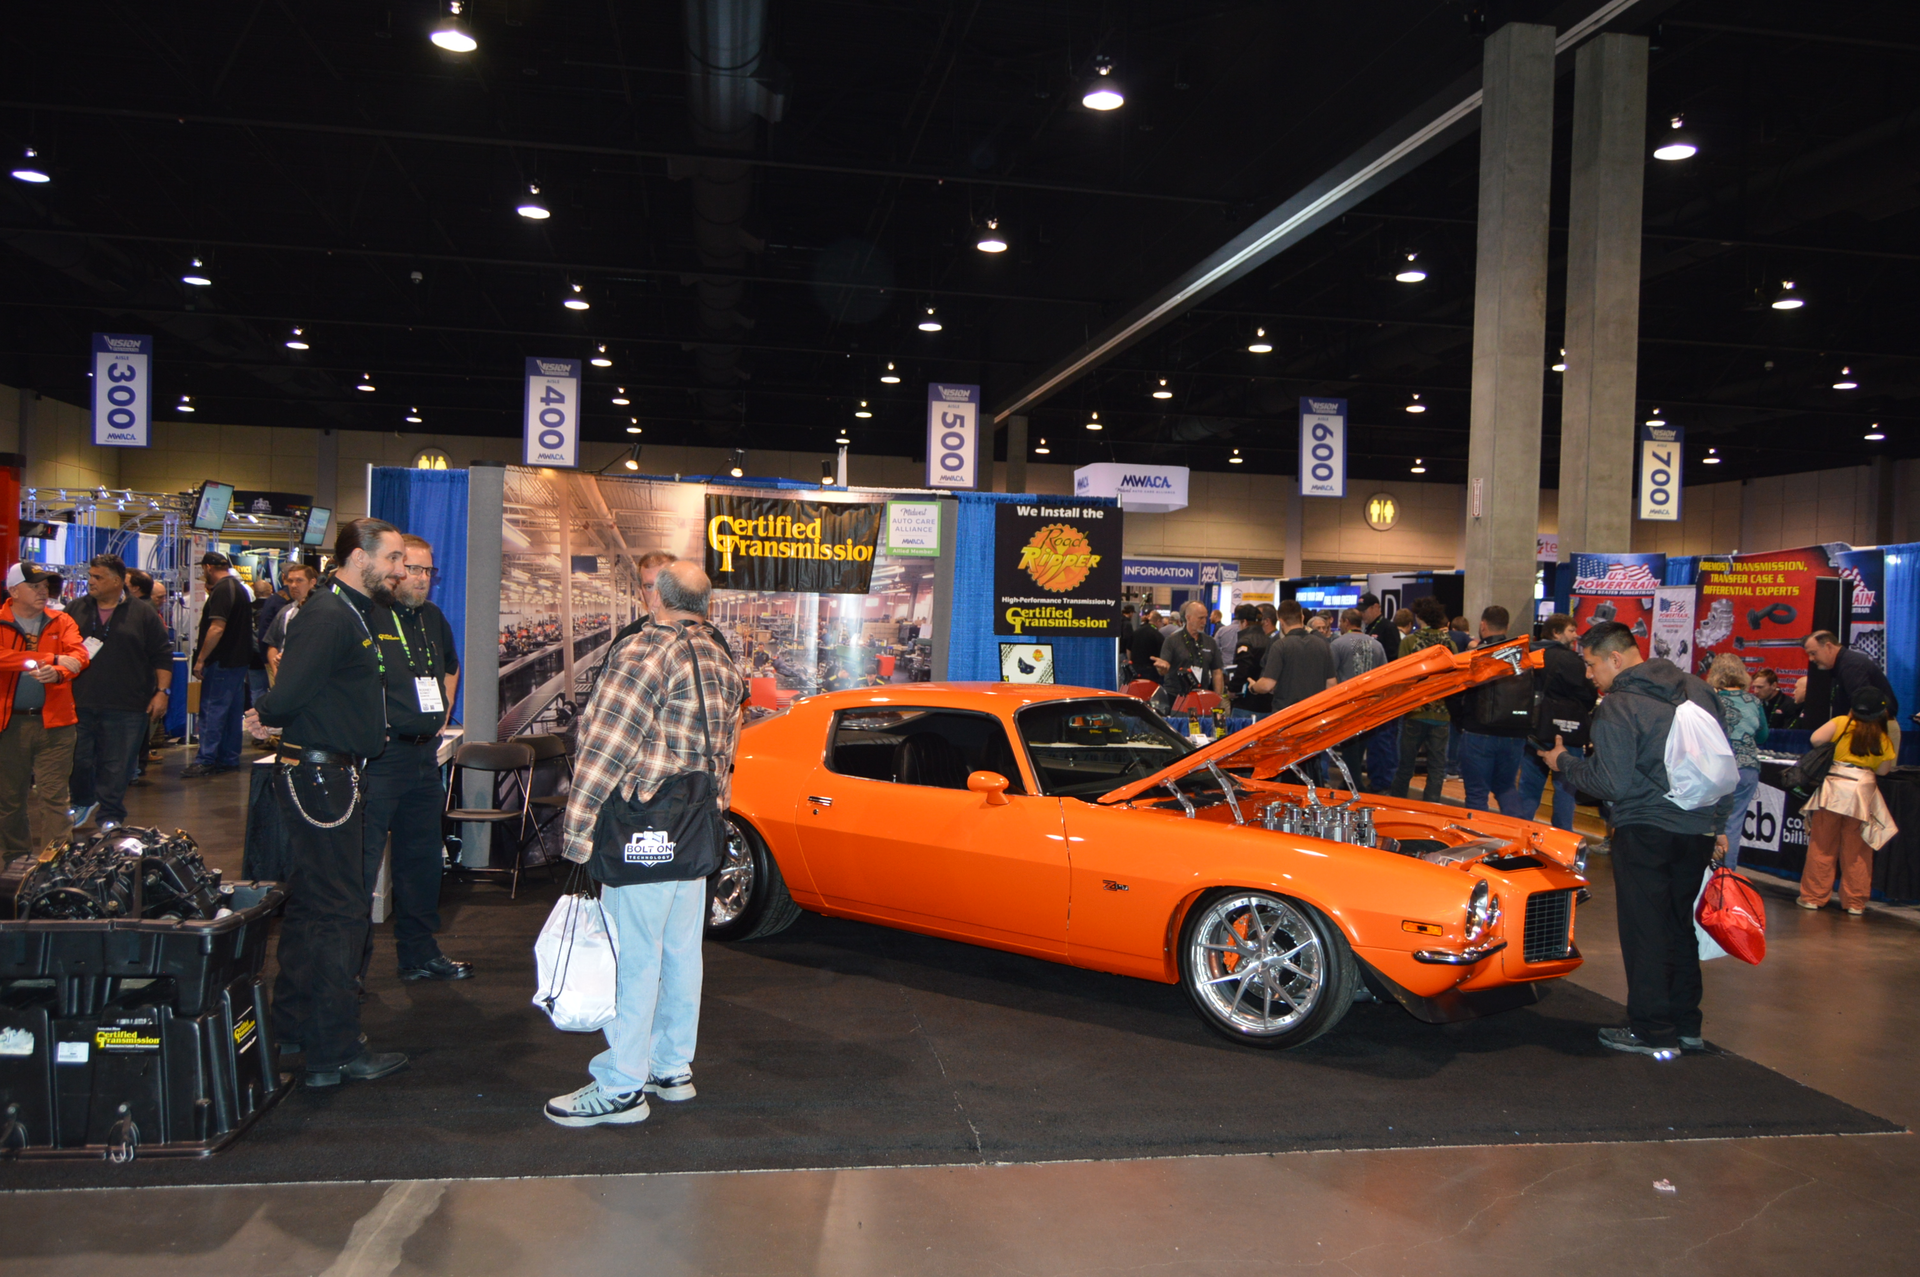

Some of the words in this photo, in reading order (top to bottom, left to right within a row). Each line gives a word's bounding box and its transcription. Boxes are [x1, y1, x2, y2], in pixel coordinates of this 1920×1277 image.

[107, 362, 136, 430] 300
[538, 385, 566, 450] 400
[940, 411, 965, 472] 500
[1311, 423, 1334, 481] 600
[1121, 474, 1172, 488] MWACA
[1649, 450, 1671, 506] 700
[1016, 505, 1039, 517] We
[1040, 506, 1080, 518] Install
[1082, 508, 1104, 519] the
[708, 515, 822, 552] Certified
[1040, 528, 1089, 553] Road
[1124, 565, 1194, 578] INFORMATION
[1699, 561, 1730, 571] FOREMOST
[1732, 561, 1808, 572] TRANSMISSION,
[1574, 579, 1661, 589] POWERTRAIN
[1710, 573, 1748, 583] TRANSFER
[1750, 573, 1774, 583] CASE
[1776, 574, 1785, 583] &
[1703, 585, 1753, 595] DIFFERENTIAL
[1755, 586, 1800, 596] EXPERTS
[1001, 596, 1062, 605] High-Performance
[1062, 597, 1106, 605] Transmission
[1005, 606, 1073, 625] Certified
[1741, 801, 1776, 843] cb
[1786, 817, 1805, 829] co
[627, 845, 654, 853] BOLT
[657, 844, 672, 853] ON
[96, 1031, 138, 1042] Certified
[98, 1037, 160, 1048] Transmission
